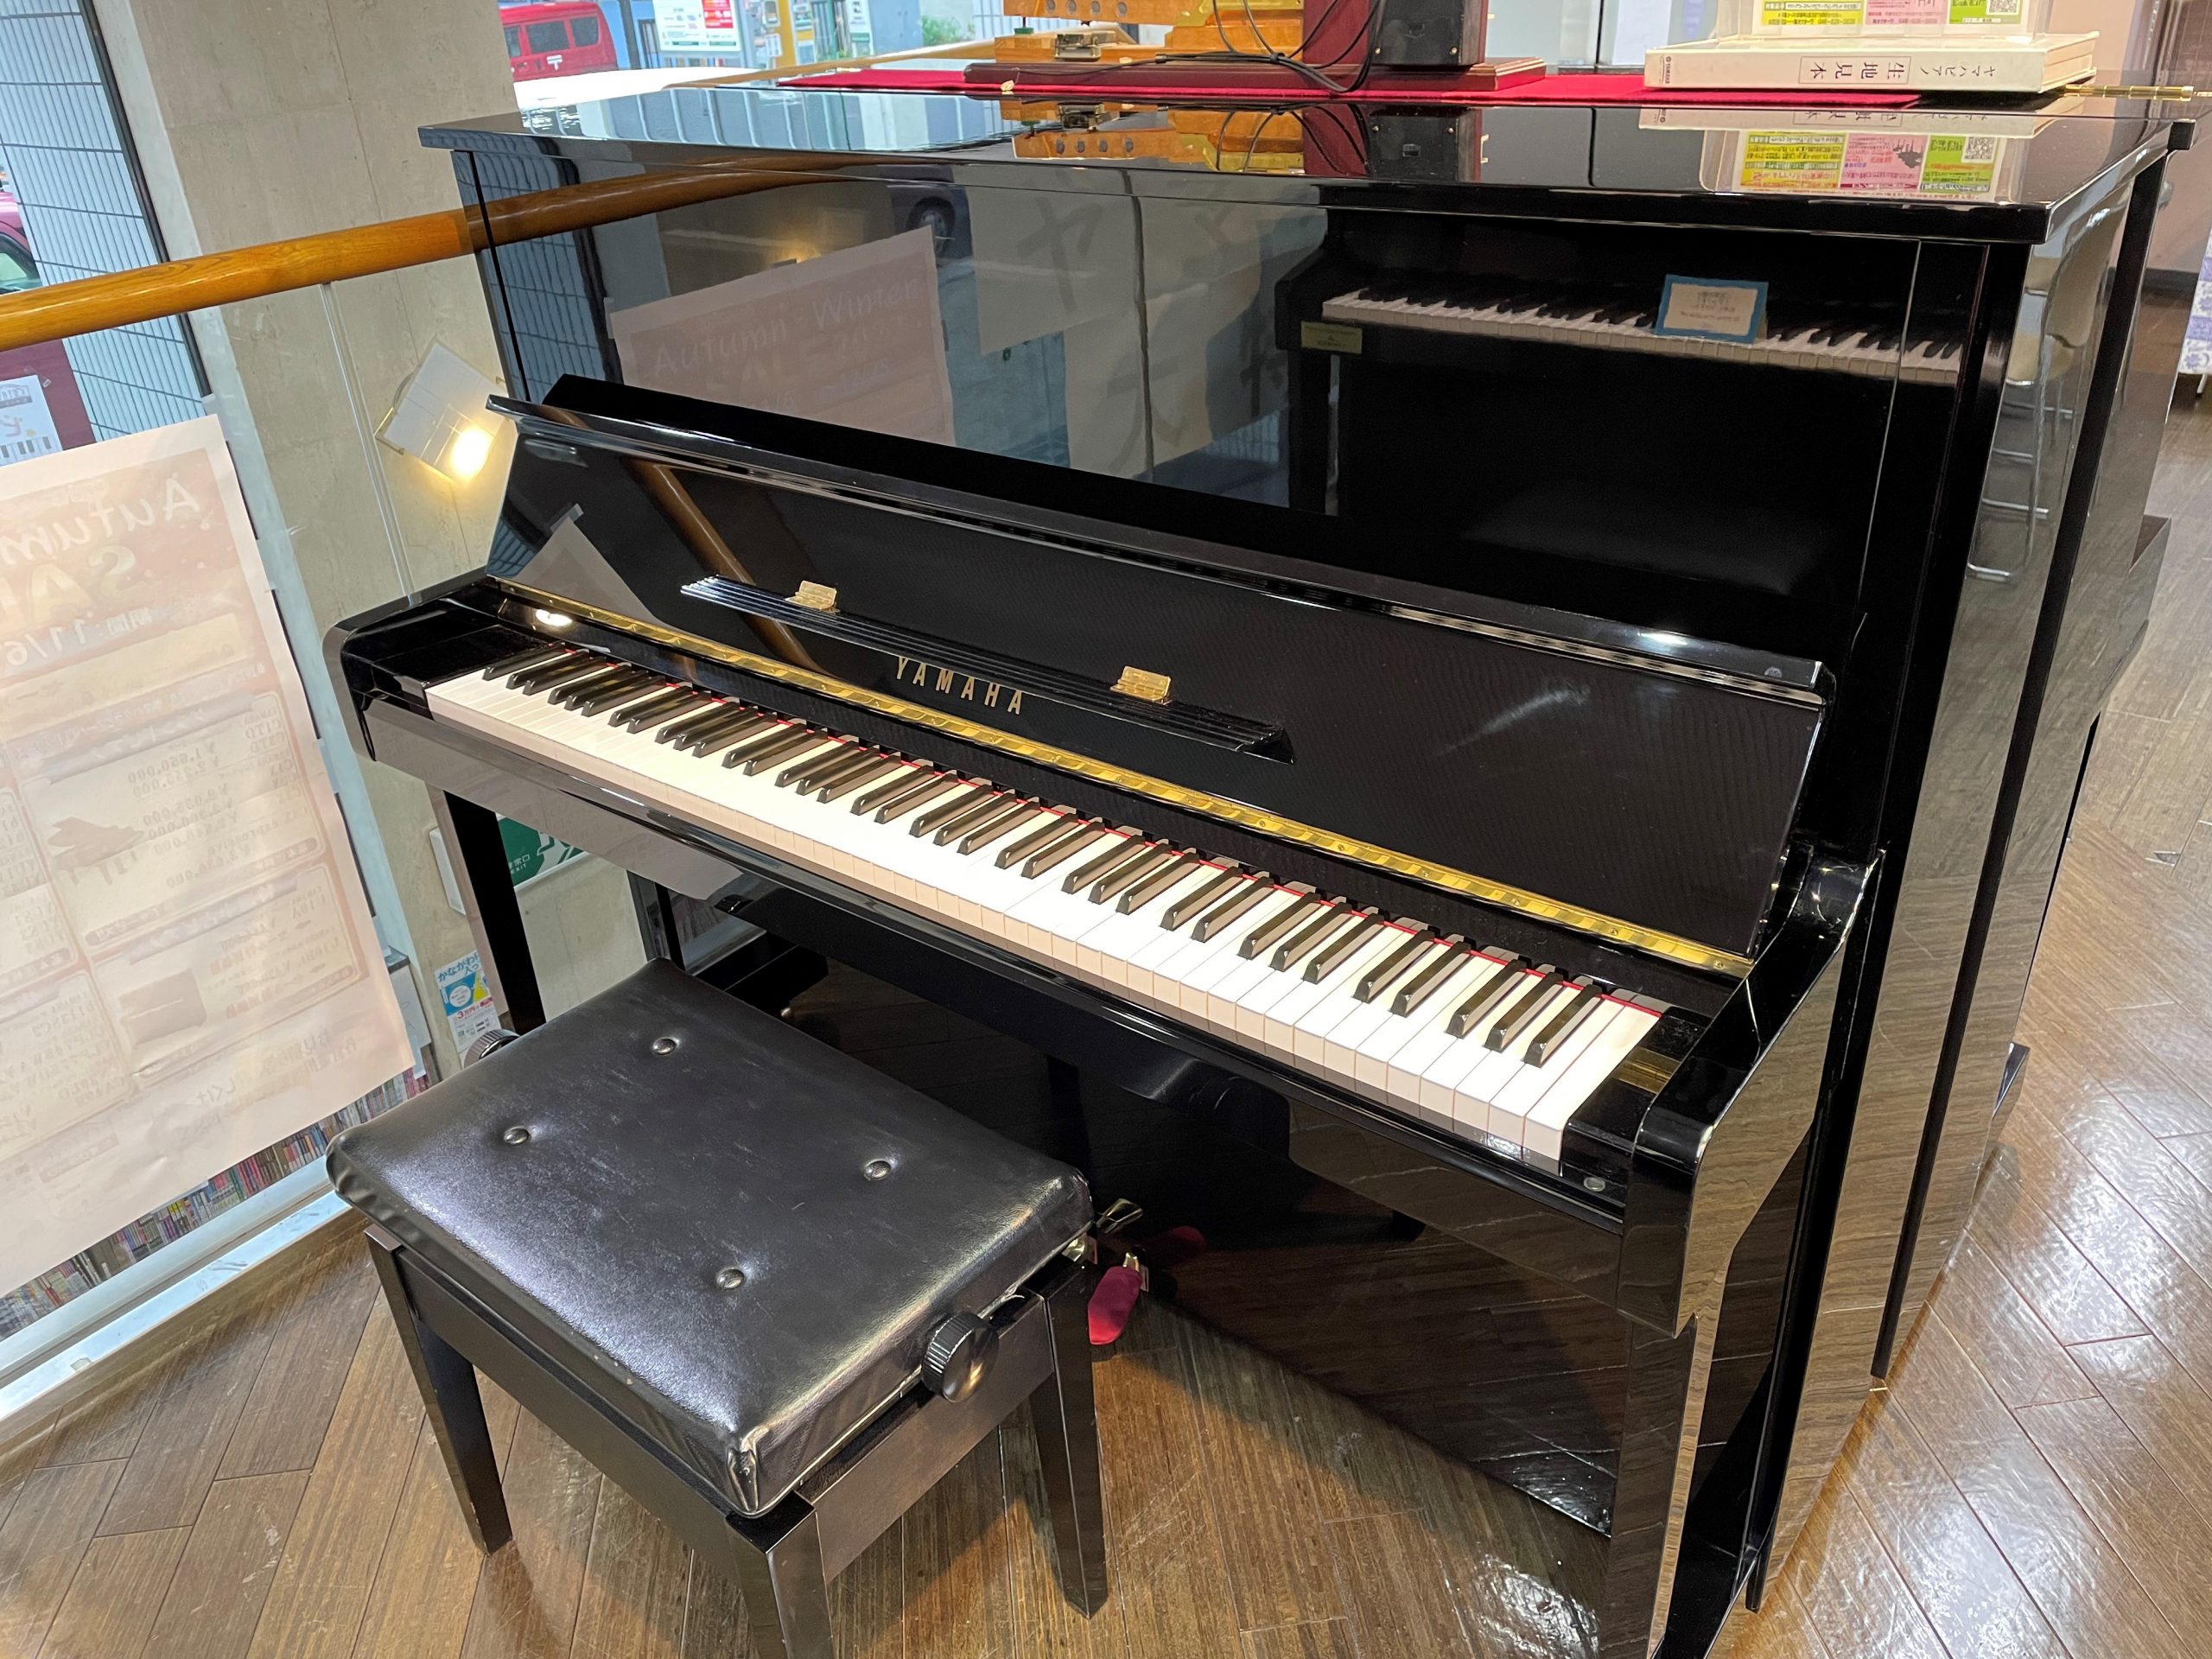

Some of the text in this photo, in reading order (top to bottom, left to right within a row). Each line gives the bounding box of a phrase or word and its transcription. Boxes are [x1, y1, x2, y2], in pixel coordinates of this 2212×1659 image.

[1810, 61, 1996, 79] ヤマハピアノ 生地見本
[896, 656, 1022, 715] YAMAHA
